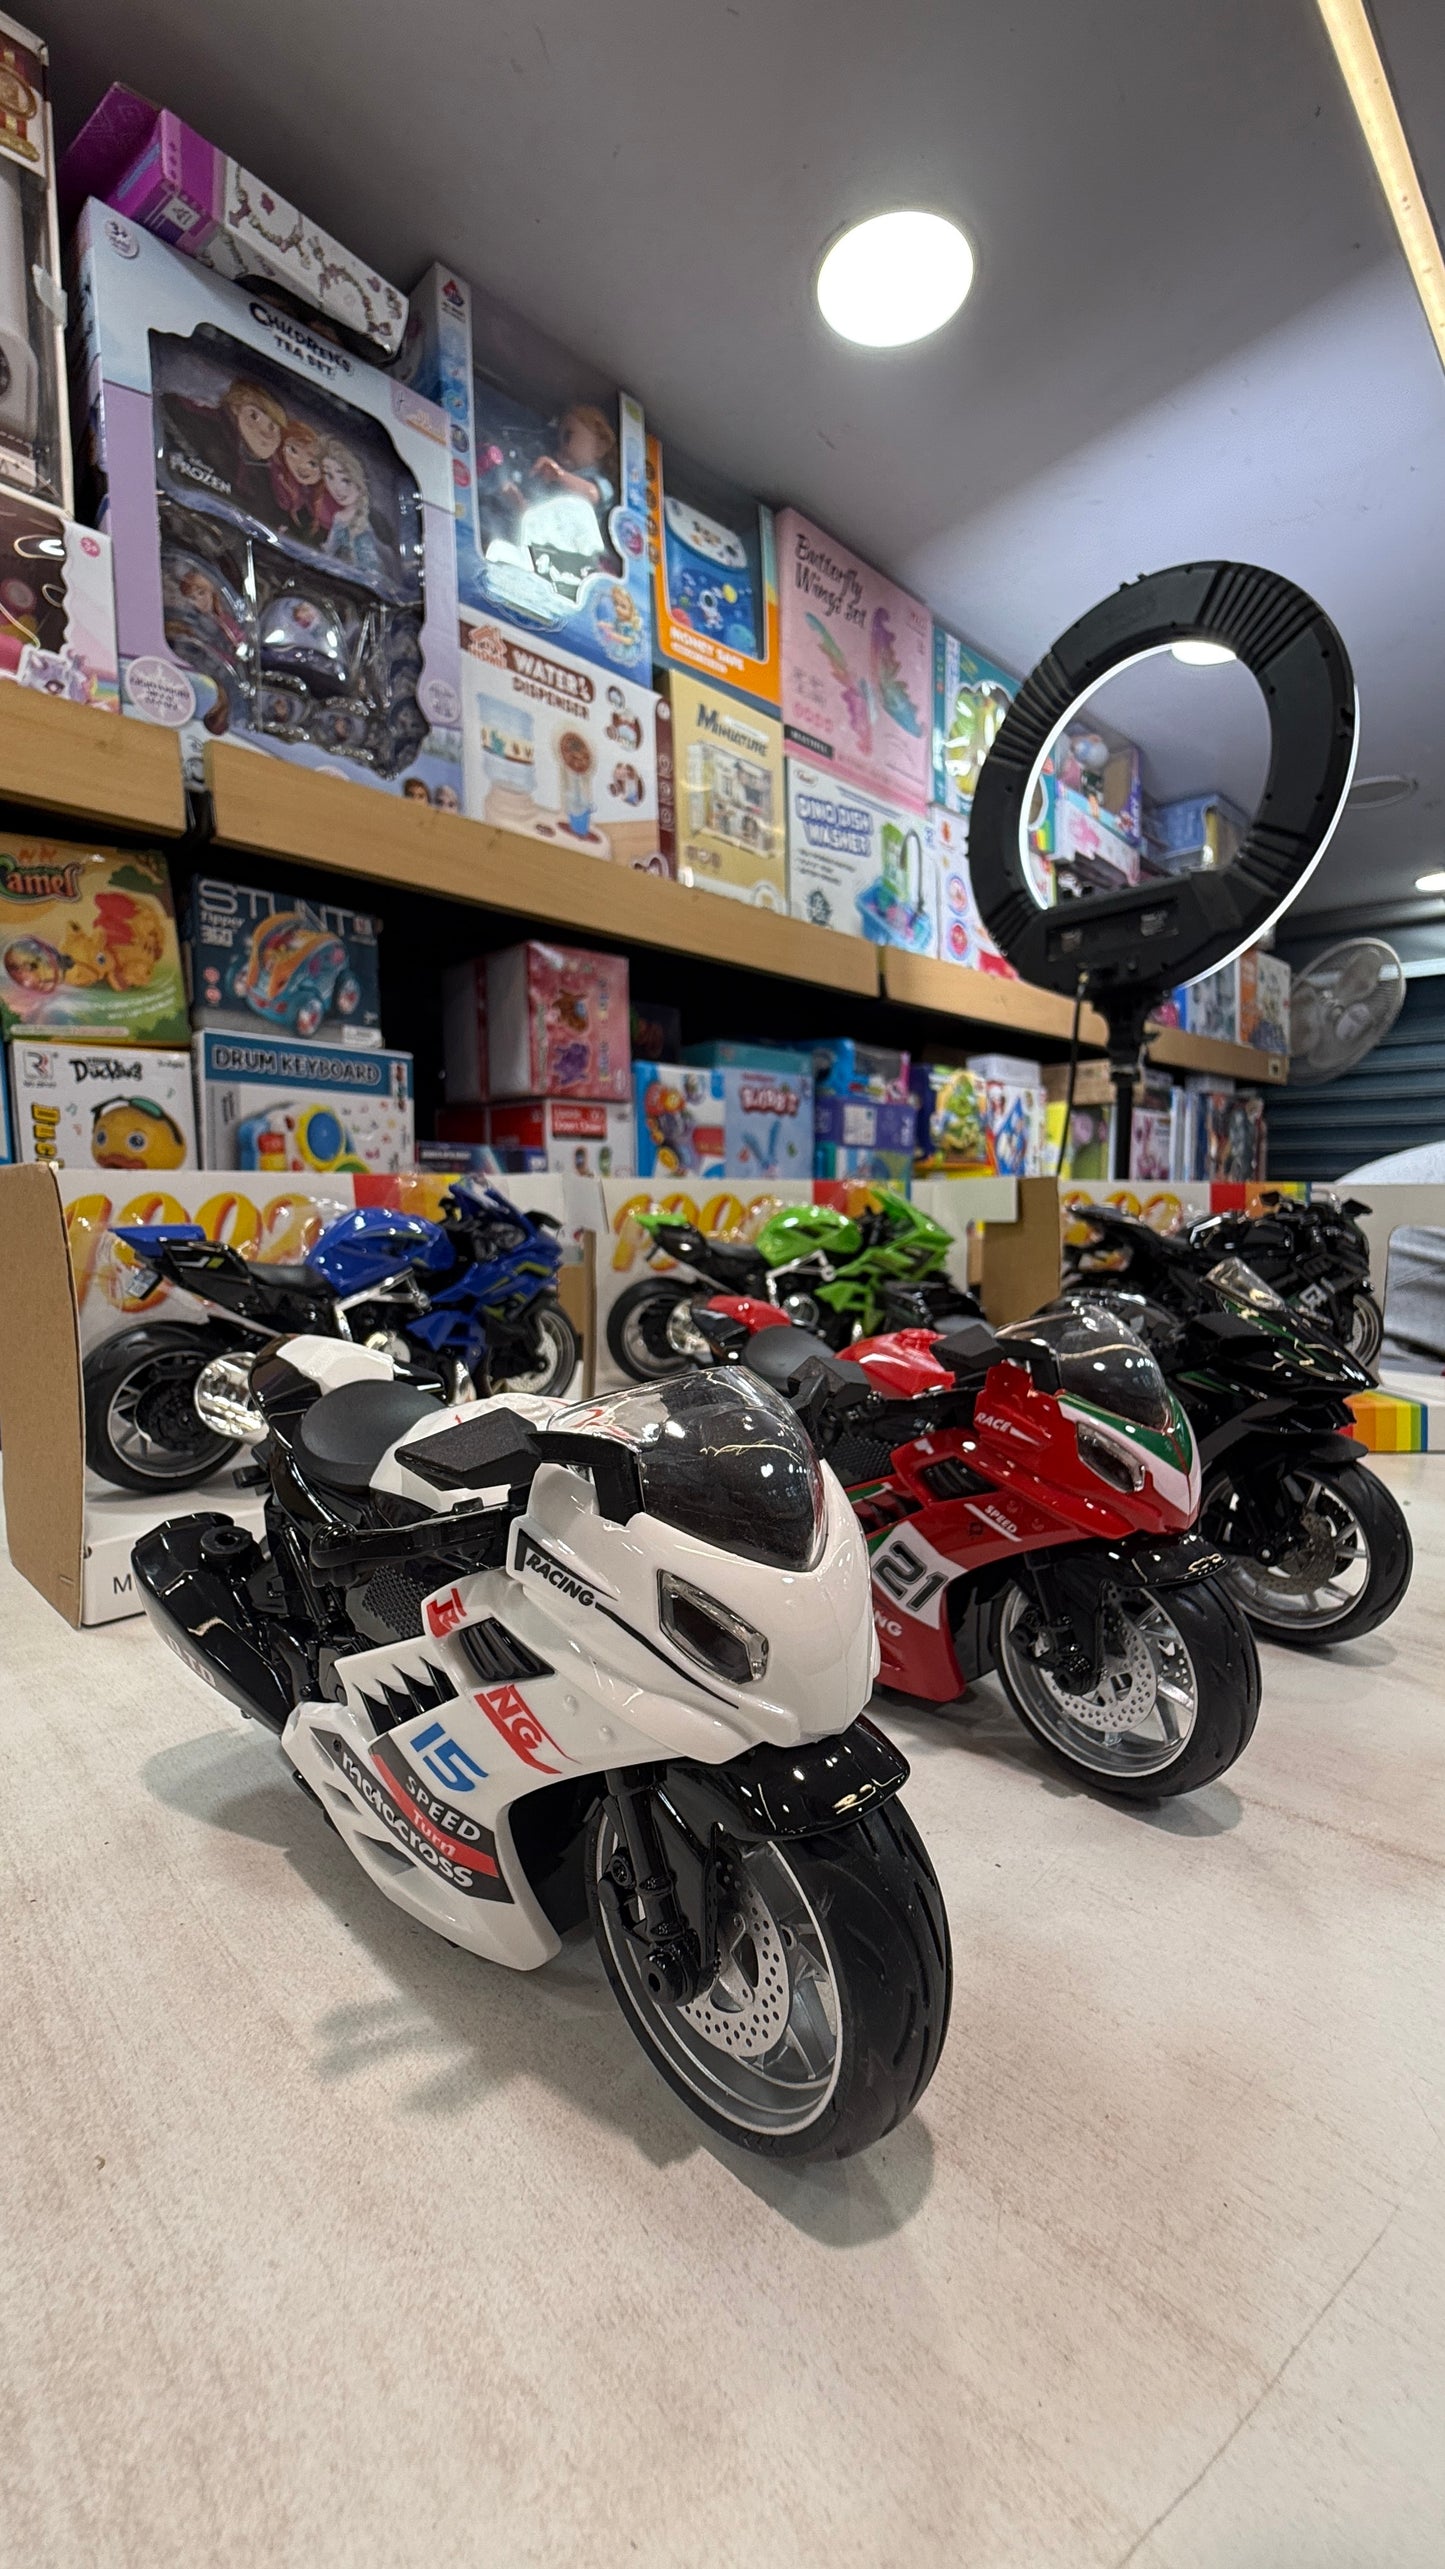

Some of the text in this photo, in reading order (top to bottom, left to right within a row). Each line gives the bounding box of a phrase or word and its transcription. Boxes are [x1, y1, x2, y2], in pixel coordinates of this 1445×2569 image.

[169, 453, 232, 495] FROZEN
[213, 1045, 381, 1085] DRUM KEYBOARD
[975, 1412, 1012, 1433] RACE
[983, 1504, 1018, 1534] SPEED
[526, 1554, 595, 1607] RACING
[872, 1540, 949, 1612] 21
[410, 1722, 489, 1792] 15
[342, 1752, 474, 1888] motocross
[405, 1776, 481, 1841] SPEED
[412, 1809, 456, 1857] Turn
